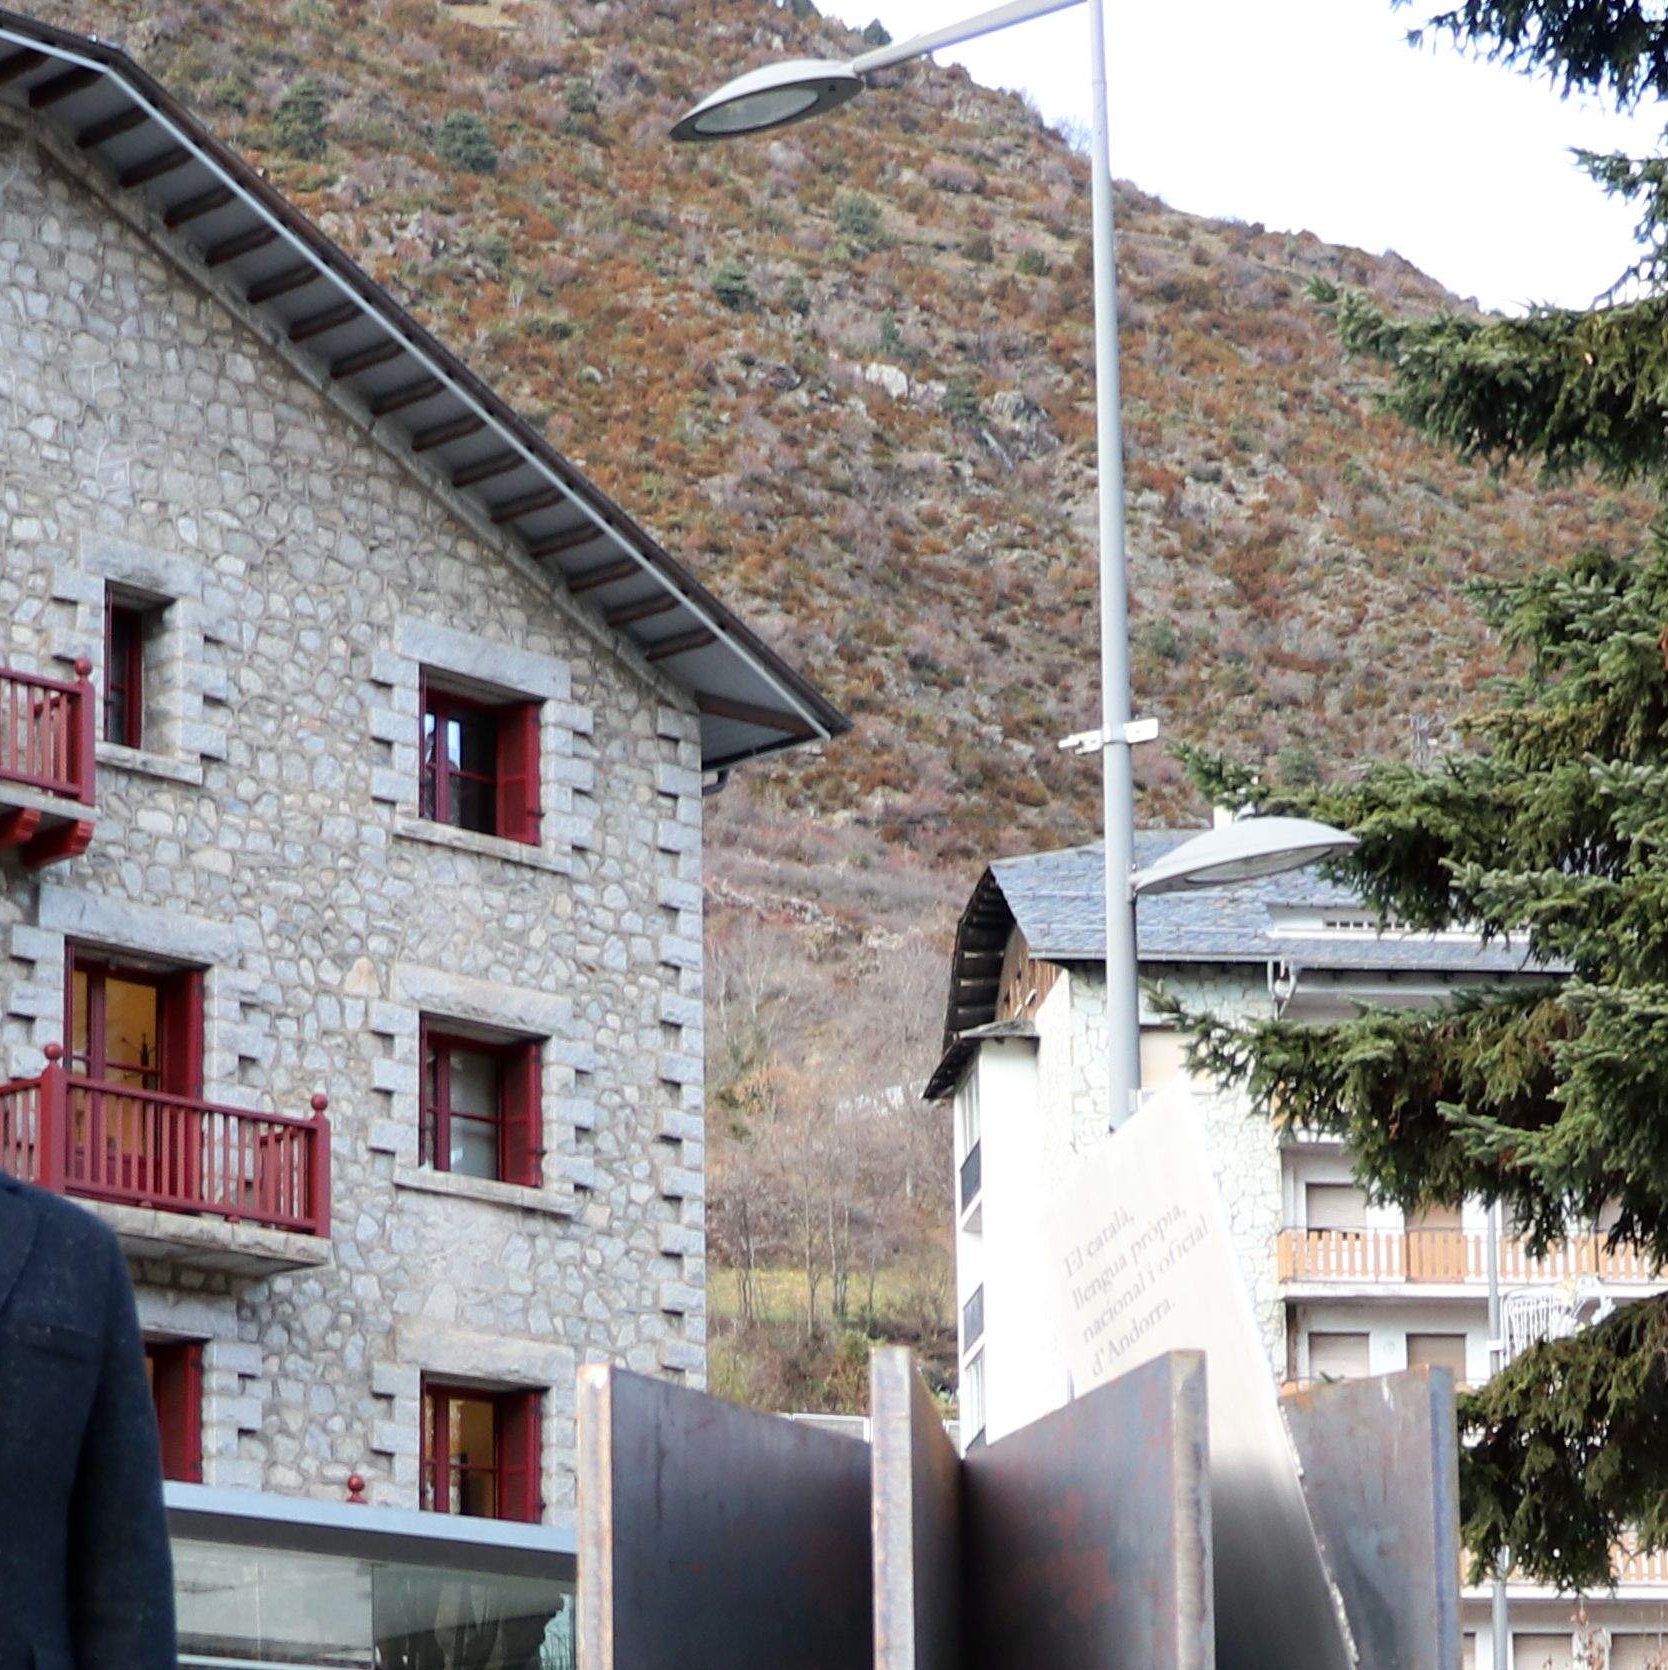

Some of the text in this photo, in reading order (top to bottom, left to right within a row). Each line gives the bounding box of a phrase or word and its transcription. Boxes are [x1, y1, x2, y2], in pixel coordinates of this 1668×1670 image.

[1064, 1205, 1135, 1278] El català,
[1071, 1203, 1187, 1312] llengua pròpia,
[1083, 1213, 1209, 1344] nacional i oficial
[1091, 1297, 1176, 1378] d'Andorra.
